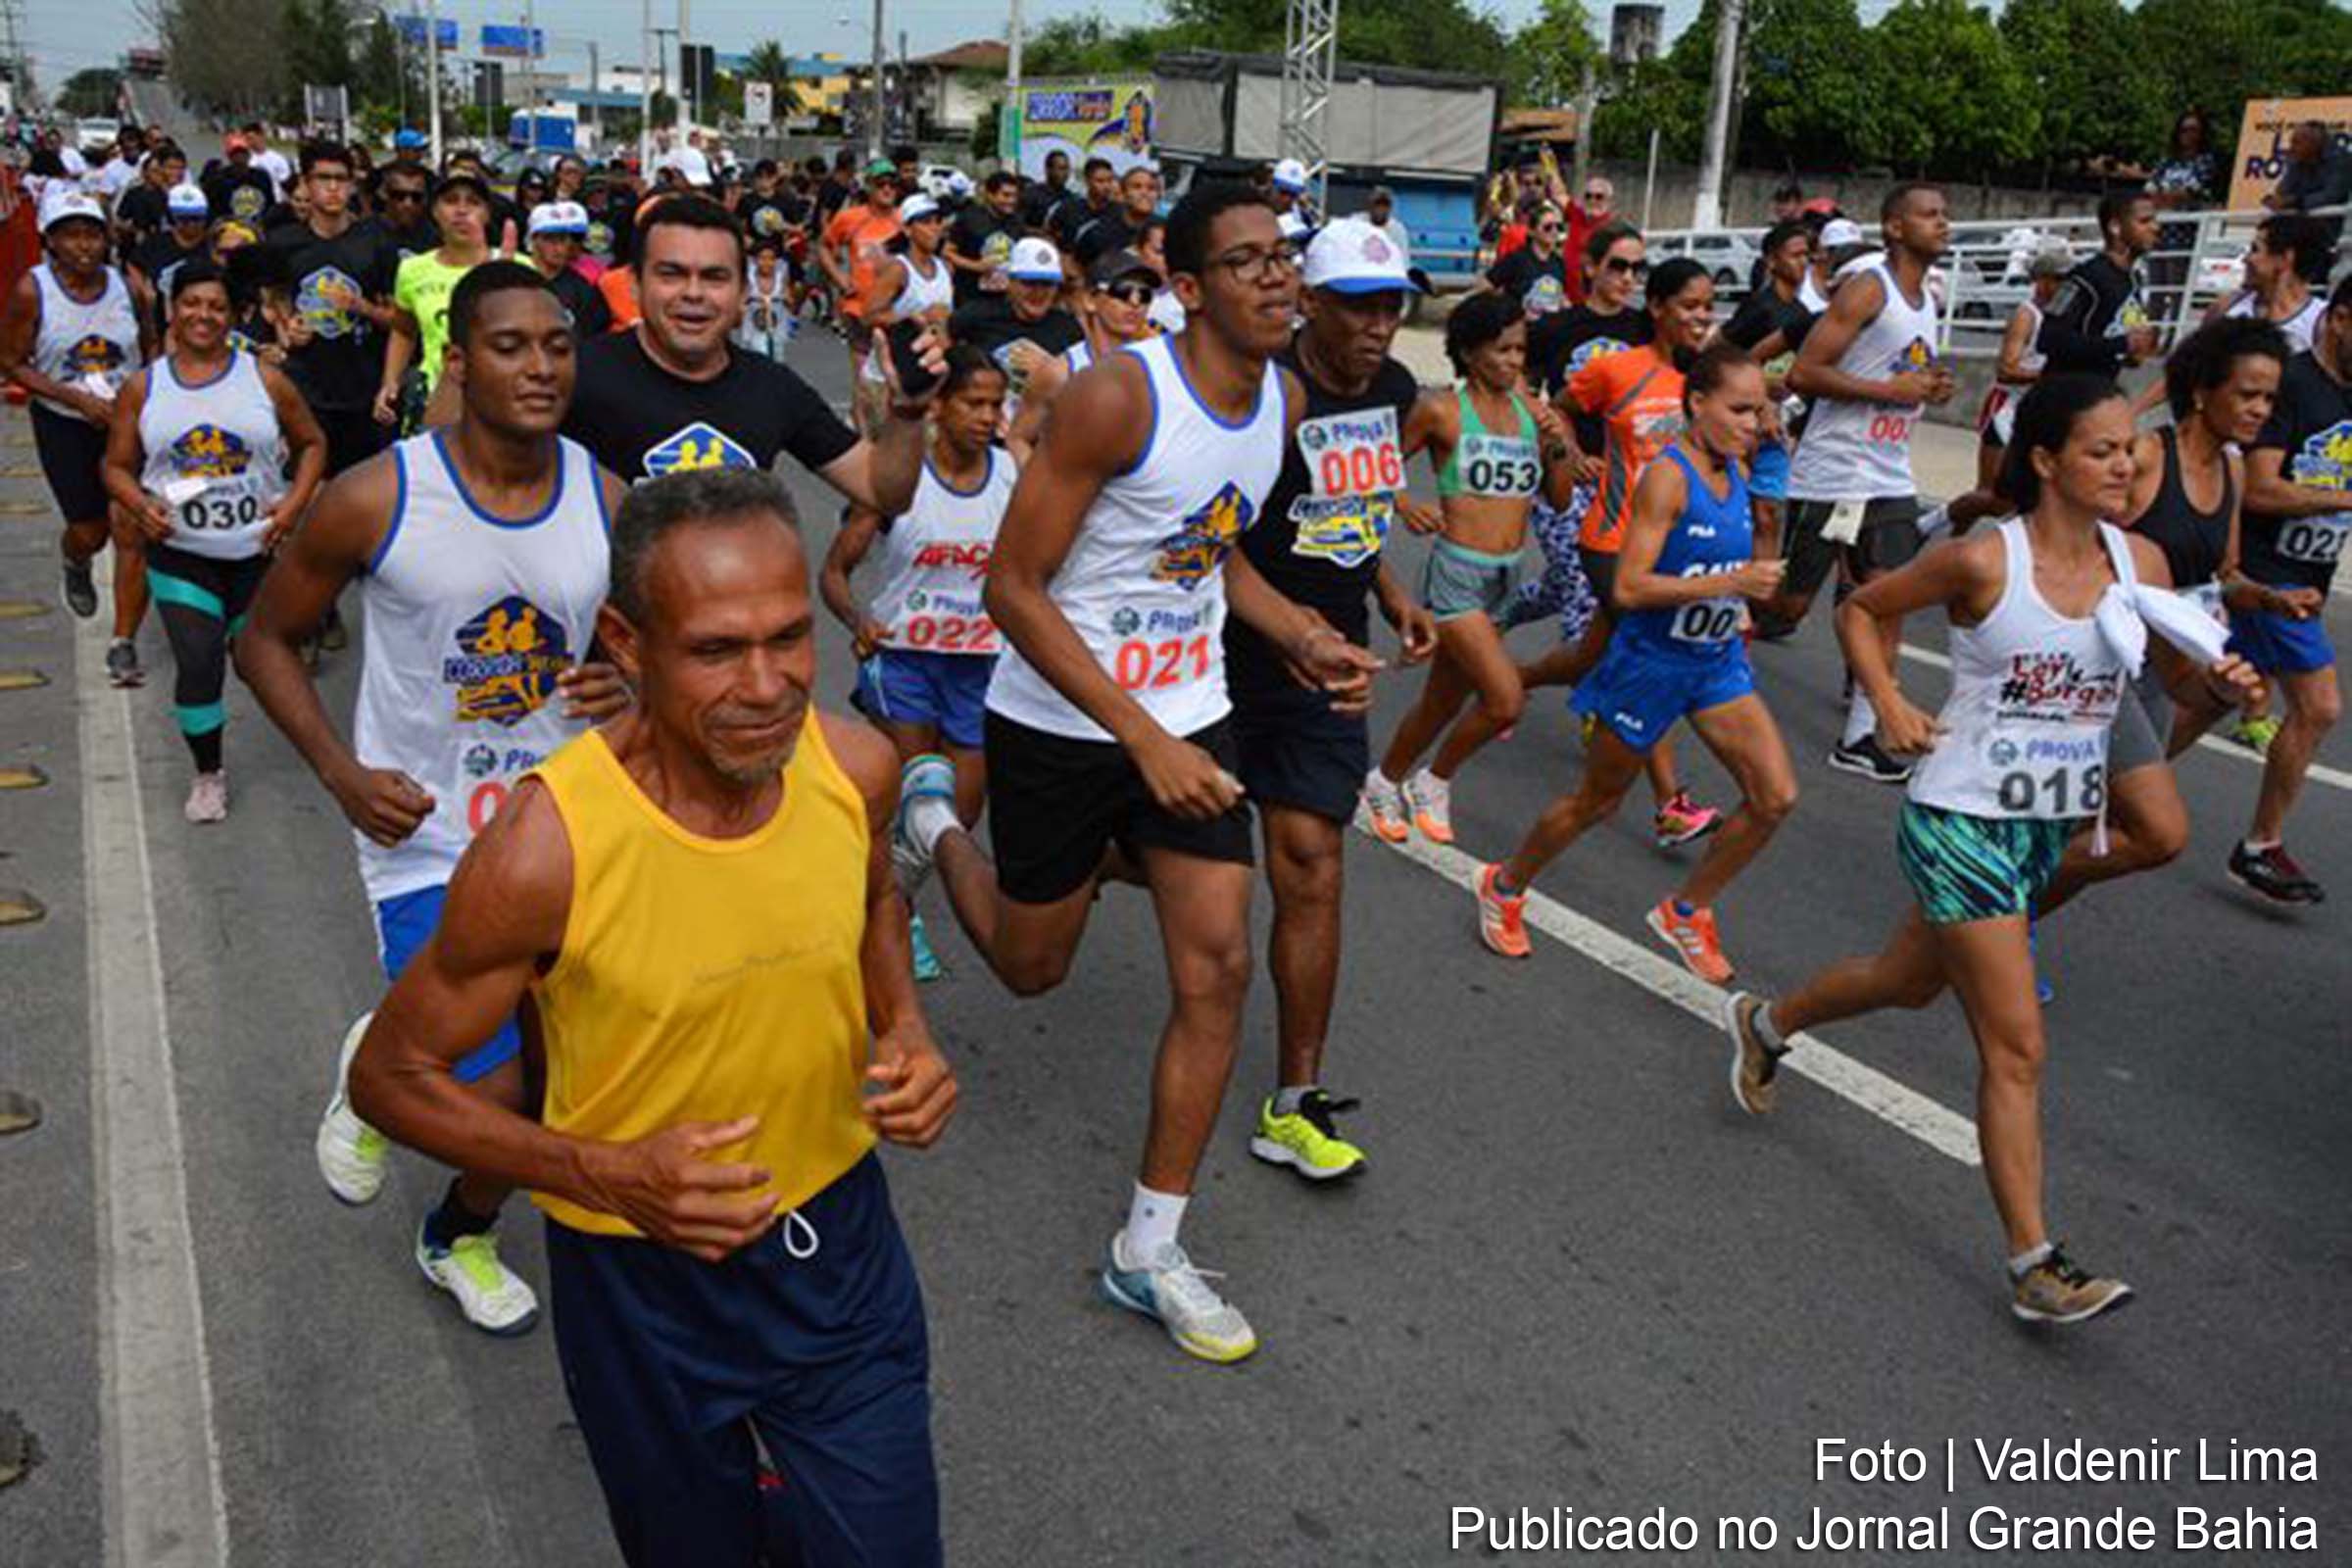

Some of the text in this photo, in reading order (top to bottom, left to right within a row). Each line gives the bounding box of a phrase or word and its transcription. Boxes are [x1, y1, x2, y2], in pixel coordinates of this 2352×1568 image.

[1870, 416, 1908, 441] 00
[1321, 442, 1400, 496] 006
[1469, 459, 1538, 492] 053
[182, 494, 257, 529] 030
[907, 615, 999, 651] 022
[1683, 604, 1735, 639] 00
[1114, 633, 1209, 690] 021
[2027, 738, 2095, 761] PROVA
[1998, 764, 2104, 813] 018
